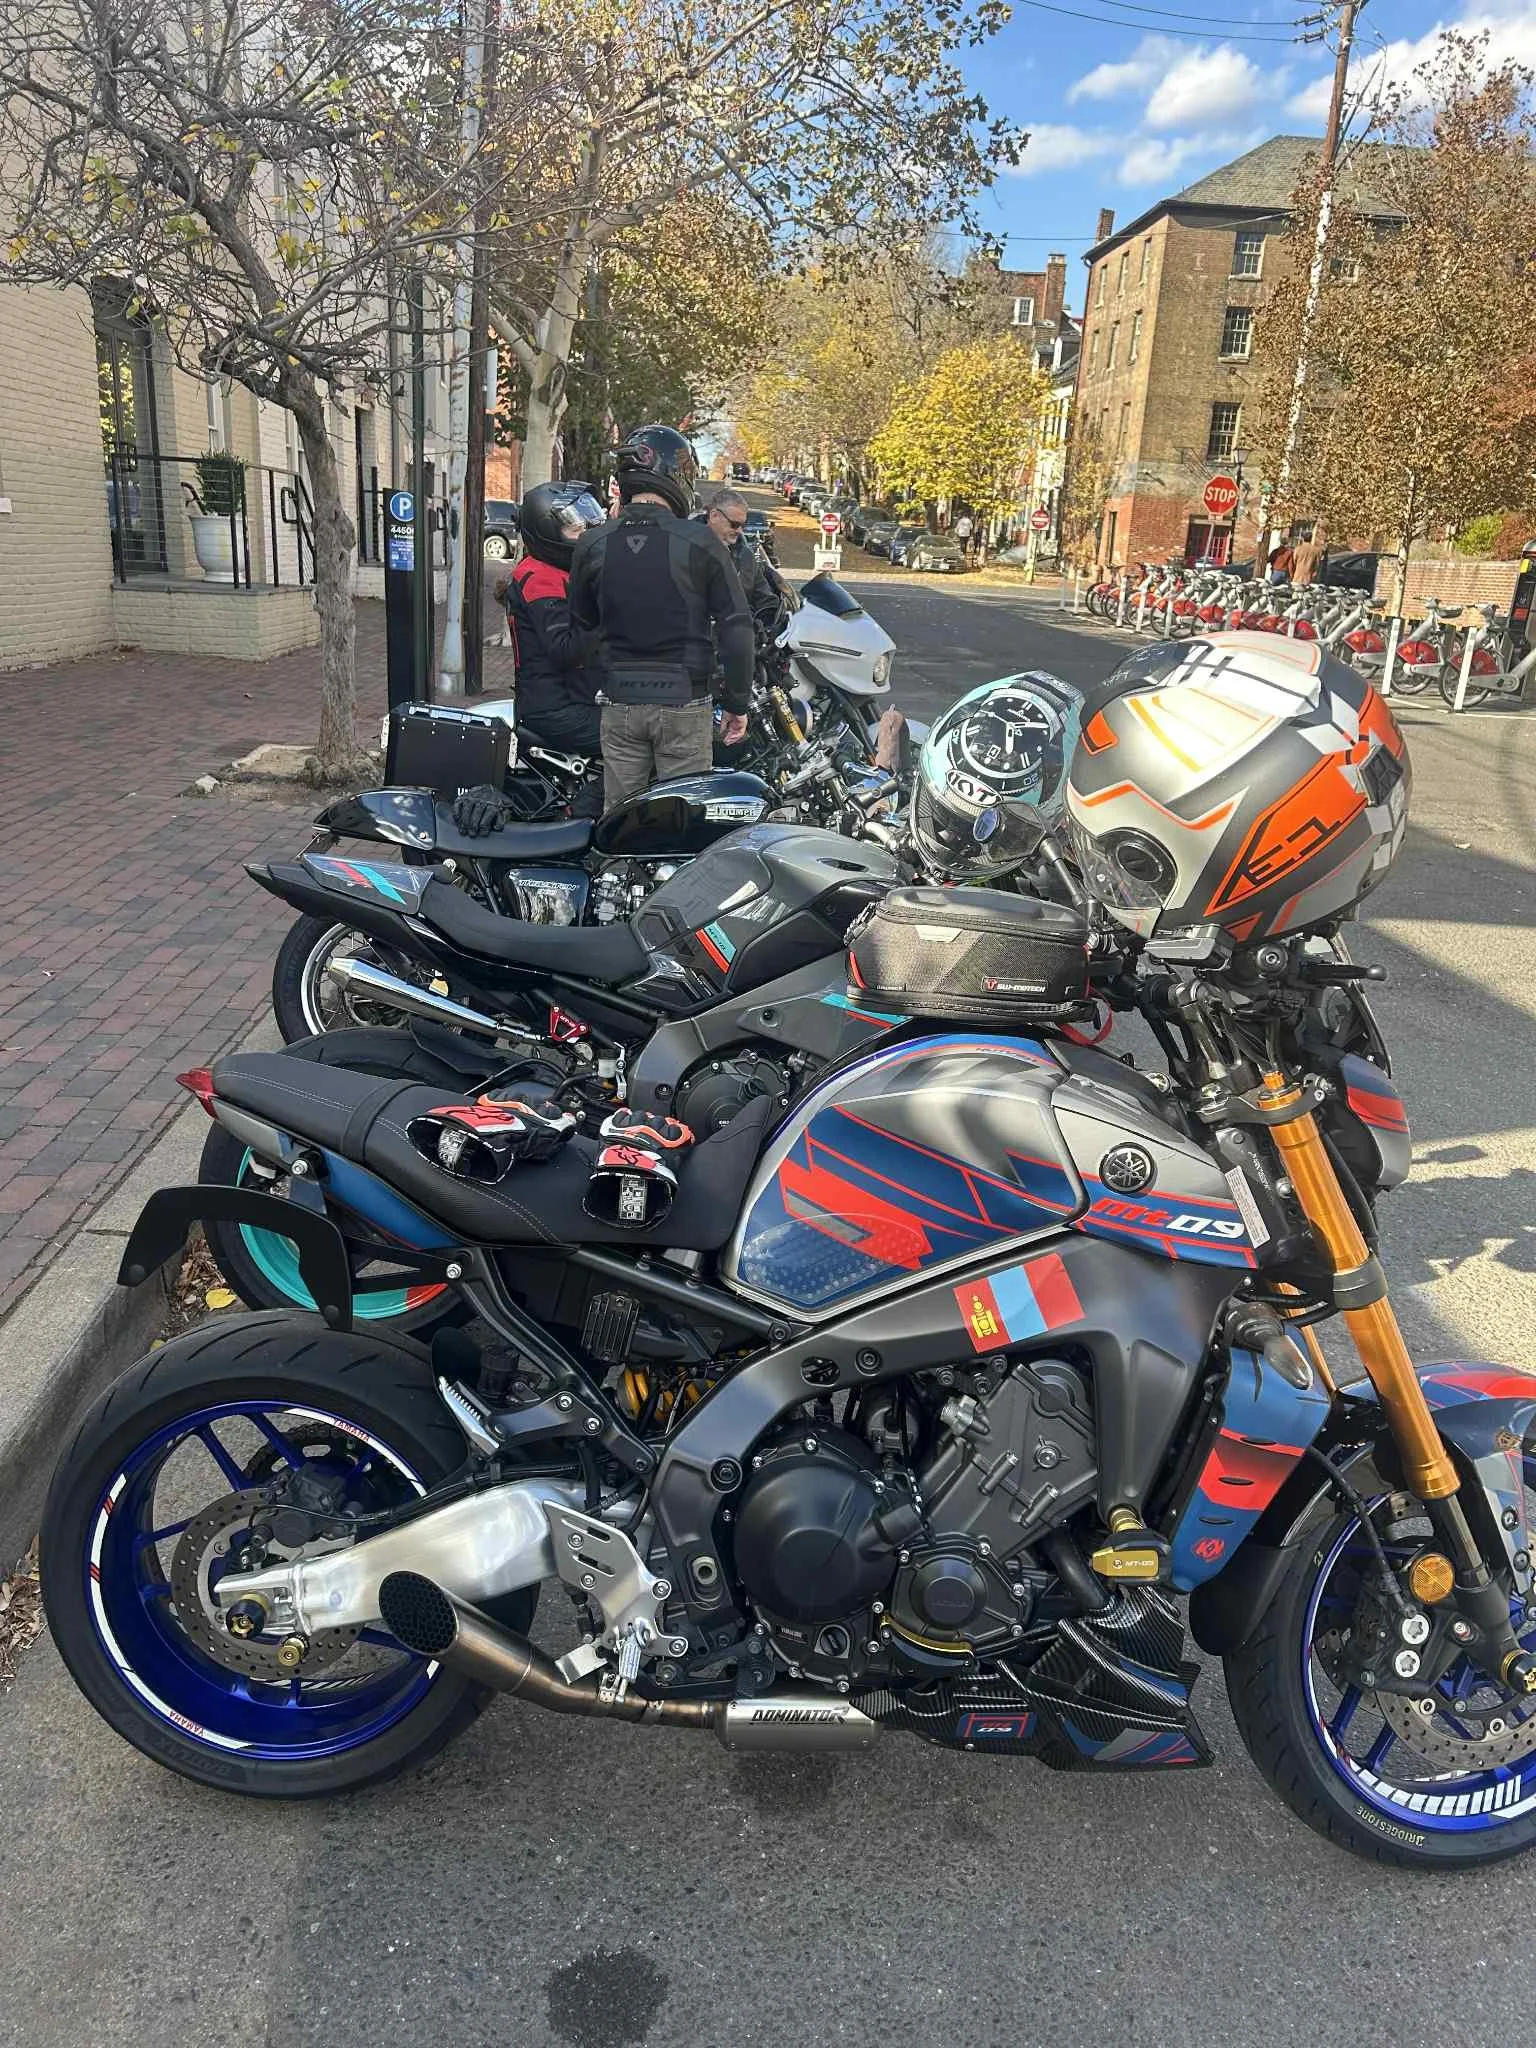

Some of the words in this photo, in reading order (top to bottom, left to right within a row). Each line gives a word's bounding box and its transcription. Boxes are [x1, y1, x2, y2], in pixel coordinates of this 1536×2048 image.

[399, 497, 411, 517] P
[1205, 486, 1237, 504] STOP
[947, 772, 1000, 807] KYT
[1165, 1214, 1245, 1239] 09
[169, 1710, 204, 1736] YAMAHA
[751, 1706, 850, 1725] DOMINATOR
[1355, 1806, 1425, 1847] BRIDGESTONE
